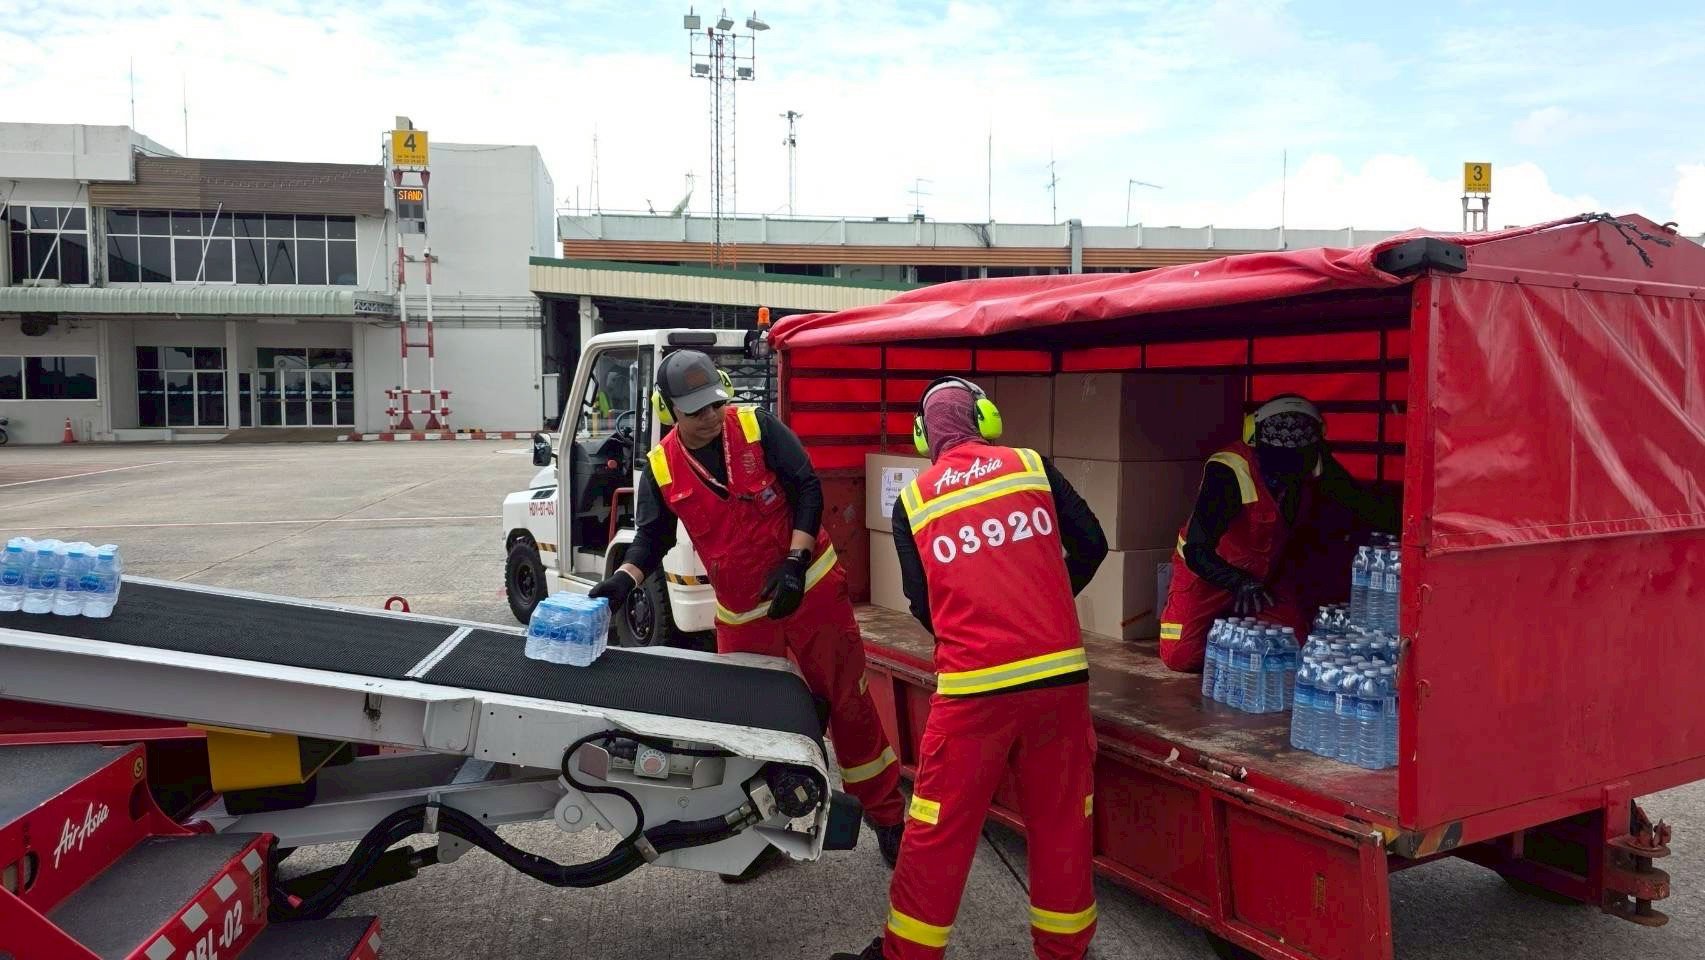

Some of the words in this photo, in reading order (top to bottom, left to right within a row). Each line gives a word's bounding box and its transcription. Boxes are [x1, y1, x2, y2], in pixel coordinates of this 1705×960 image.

[404, 133, 416, 153] 4
[1473, 165, 1483, 181] 3
[398, 190, 423, 201] STAND
[934, 457, 1003, 494] AirAsia
[932, 506, 1053, 563] 03920
[53, 801, 110, 869] AirAsia
